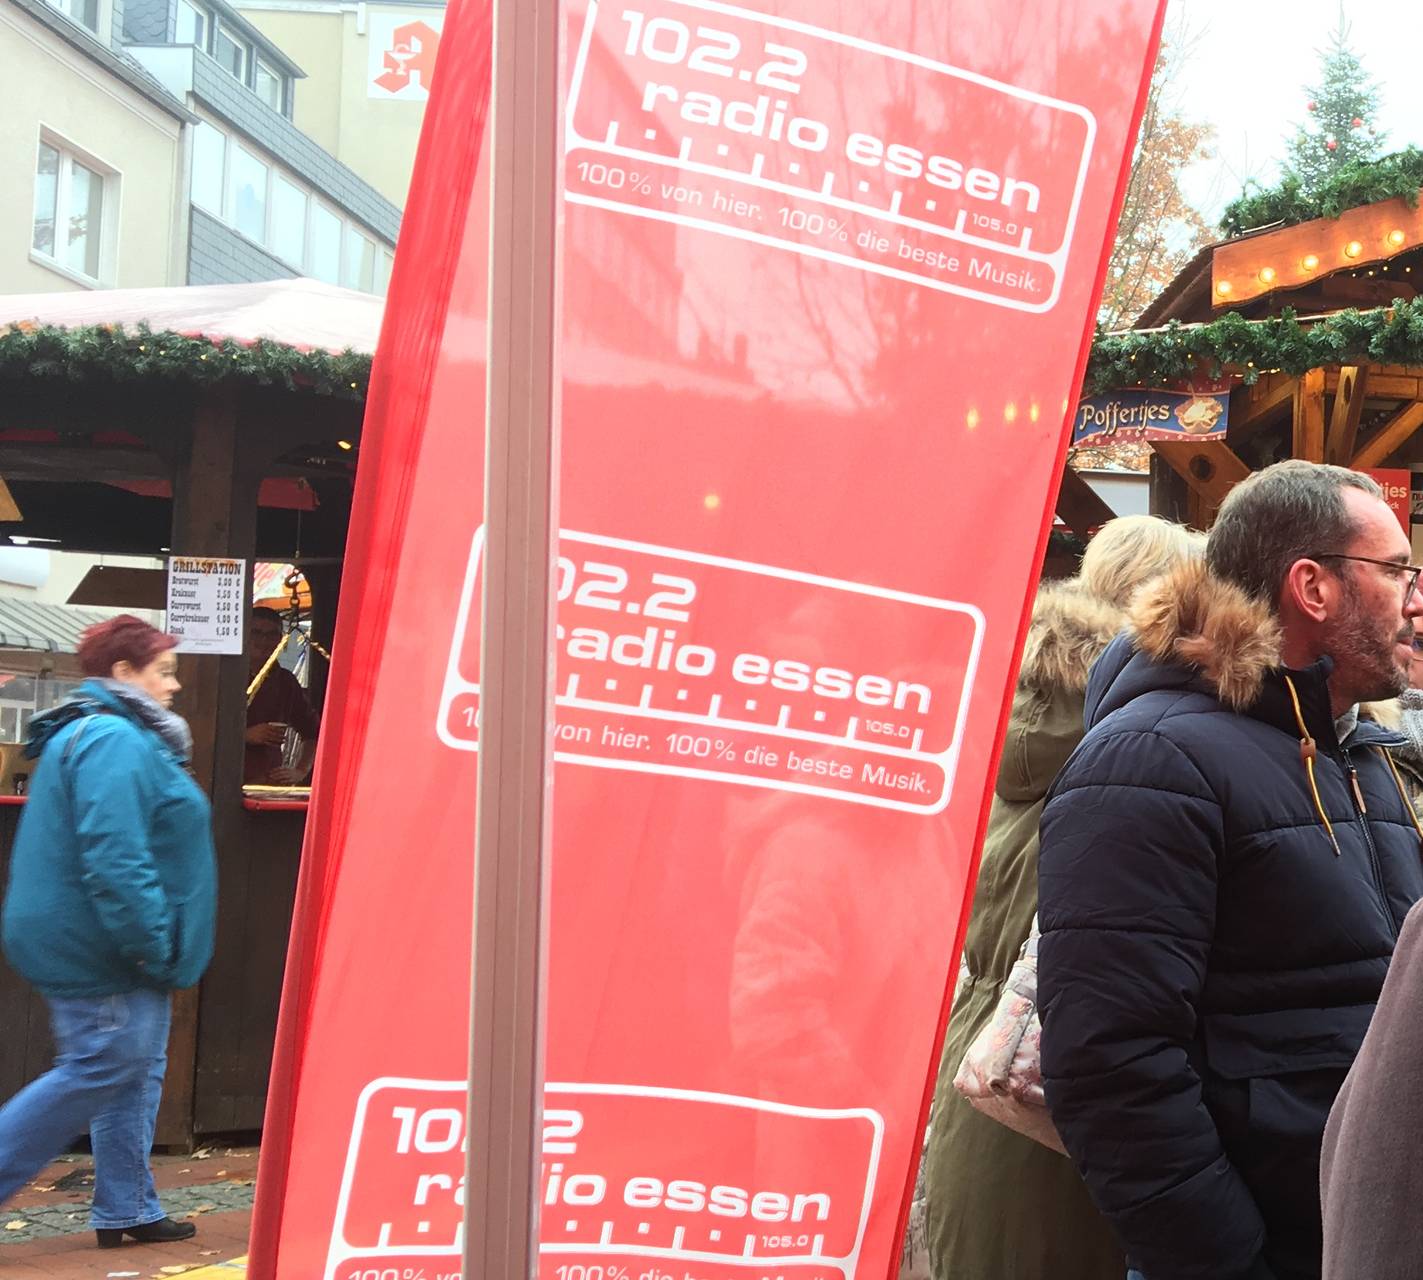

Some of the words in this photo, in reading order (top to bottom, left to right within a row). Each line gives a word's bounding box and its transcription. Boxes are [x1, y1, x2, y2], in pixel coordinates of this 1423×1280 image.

[619, 10, 808, 94] 102.2
[641, 80, 829, 151] radio
[845, 131, 1040, 213] essen
[576, 162, 652, 195] 100%
[660, 183, 703, 206] von
[713, 190, 764, 221] hier.
[777, 206, 848, 242] 100%
[856, 227, 890, 254] die
[898, 238, 961, 273] beste
[968, 257, 1042, 293] Musik.
[972, 213, 1017, 236] 105.0
[1079, 401, 1170, 434] Poffertjes
[173, 560, 241, 575] GRILLSTATION
[557, 624, 715, 677] adio
[732, 652, 932, 714] essen
[865, 719, 910, 738] 105.0
[601, 725, 651, 750] hier.
[666, 733, 737, 762] 100%
[744, 745, 778, 769] die
[787, 752, 853, 780] beste
[861, 762, 932, 794] Musik.
[391, 1106, 584, 1154] 102
[413, 1163, 607, 1207] rio
[623, 1175, 831, 1223] essen
[761, 1235, 809, 1248] 105.0
